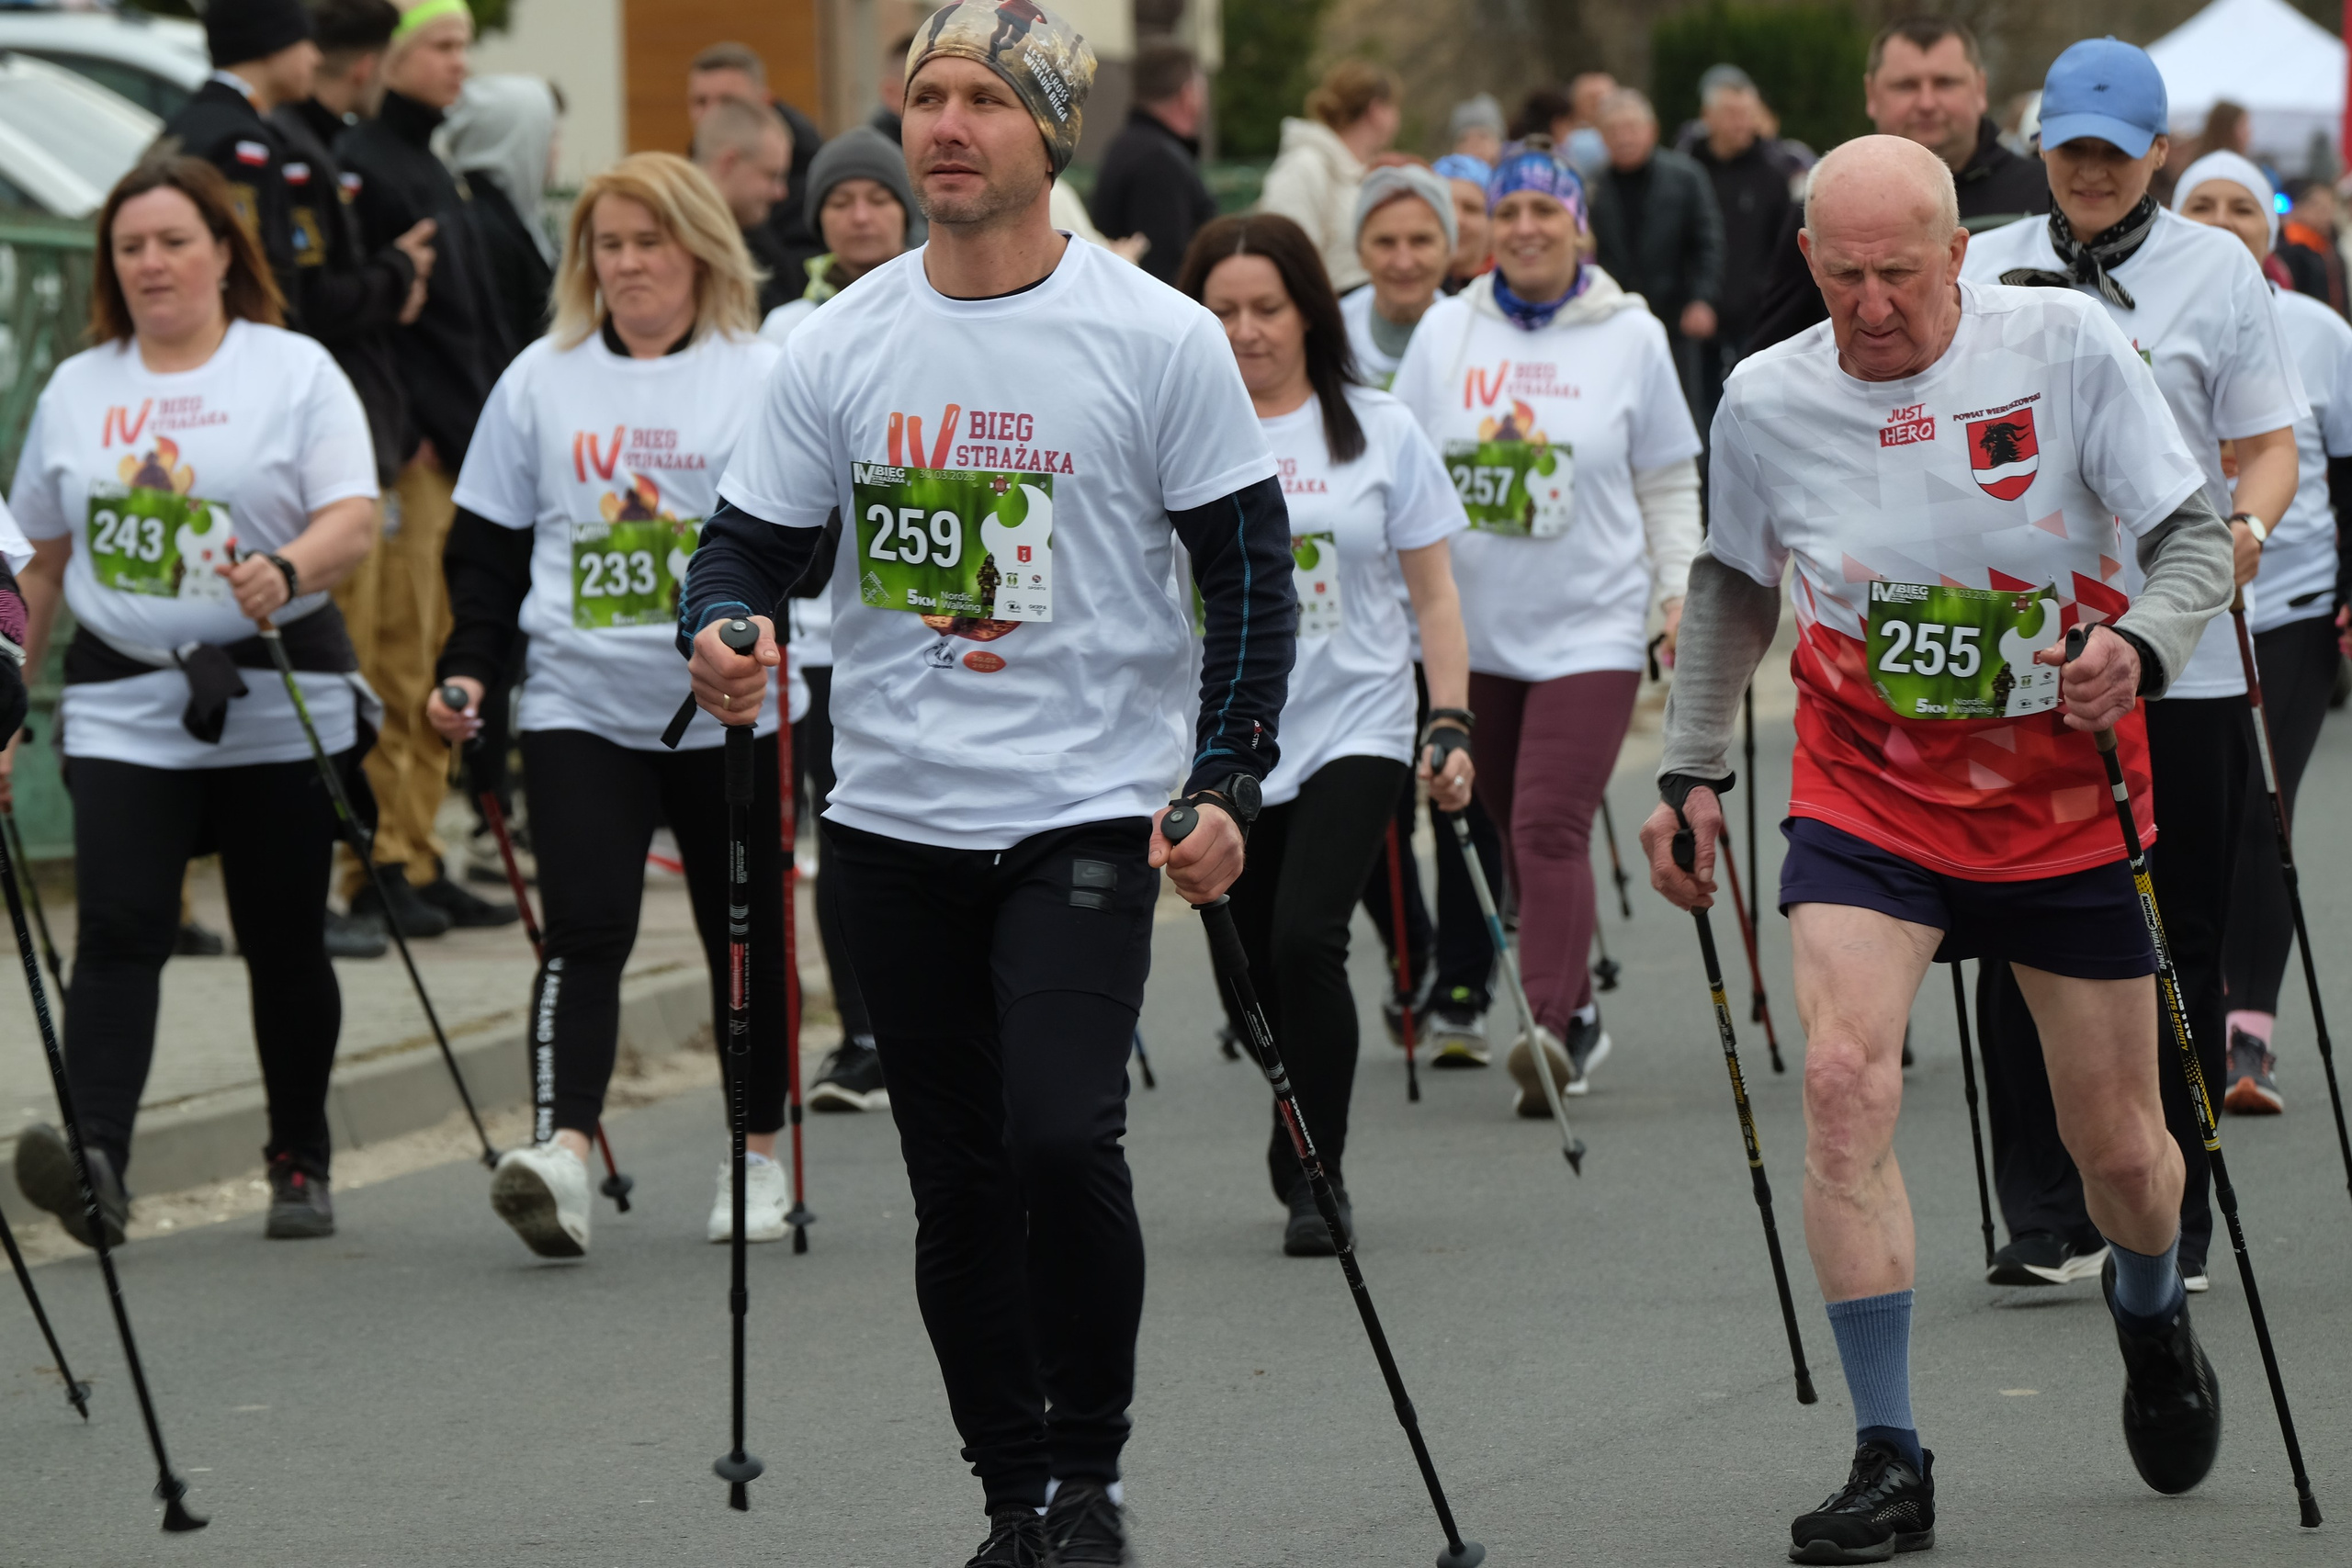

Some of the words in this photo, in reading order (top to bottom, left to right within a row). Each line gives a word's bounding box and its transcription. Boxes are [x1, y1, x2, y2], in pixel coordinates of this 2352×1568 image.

[1048, 73, 1069, 103] CROSS
[1048, 91, 1069, 122] BIEGA
[1464, 359, 1510, 410] IV
[1887, 402, 1927, 423] JUST
[1953, 409, 1984, 422] POWIAT
[1986, 391, 2041, 416] WIERUSZOWSKI
[101, 397, 153, 449] IV
[888, 403, 961, 470] IV
[968, 411, 1034, 442] BIEG
[1884, 422, 1933, 445] HERO
[572, 424, 626, 483] IV
[631, 428, 678, 449] BIEG
[956, 443, 1074, 475] STRAŻAKA
[853, 462, 876, 485] IV
[875, 466, 906, 479] BIEG
[919, 469, 977, 482] 30.03.2025
[1452, 464, 1515, 507] 257
[93, 509, 165, 563] 243
[866, 503, 962, 568] 259
[579, 550, 657, 598] 233
[907, 588, 936, 608] 5KM
[940, 590, 974, 603] Nordic
[941, 600, 982, 614] Walking
[1871, 581, 1897, 603] IV
[1895, 584, 1929, 596] BIEG
[1942, 588, 1999, 601] 30.03.2025
[1878, 619, 1981, 678] 255
[1915, 698, 1948, 714] 5KM
[1953, 697, 1987, 706] Nordic
[1952, 705, 1995, 716] Walking
[2141, 894, 2156, 928] NORDIC
[2150, 929, 2167, 970] WALKING
[2163, 976, 2177, 1010] SPORTS
[2172, 1011, 2188, 1051] ACTIVITY
[1289, 1095, 1314, 1151] ANTISHOCK
